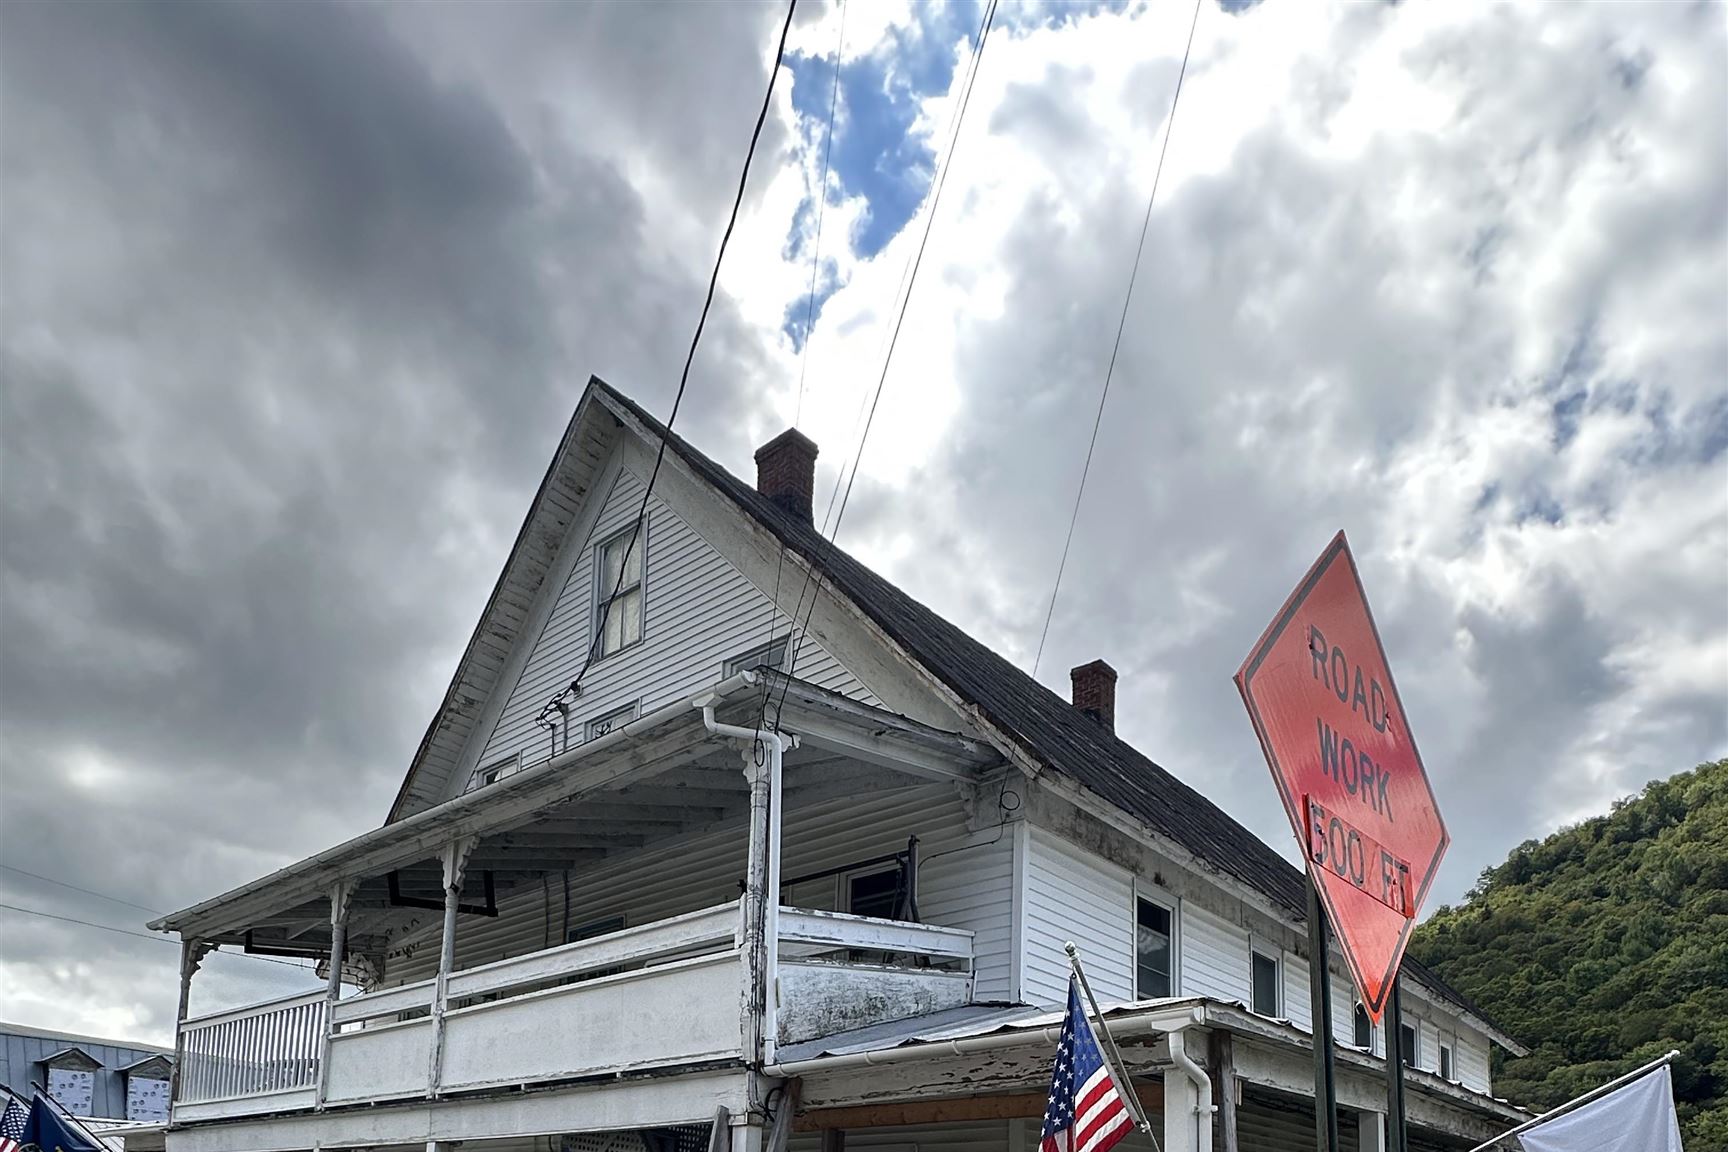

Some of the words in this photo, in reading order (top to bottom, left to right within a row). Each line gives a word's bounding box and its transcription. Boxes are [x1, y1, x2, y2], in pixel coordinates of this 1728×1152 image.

[1310, 624, 1386, 733] ROAD
[1317, 717, 1393, 823] WORK
[1311, 803, 1365, 887] 500
[1380, 849, 1409, 914] FT
